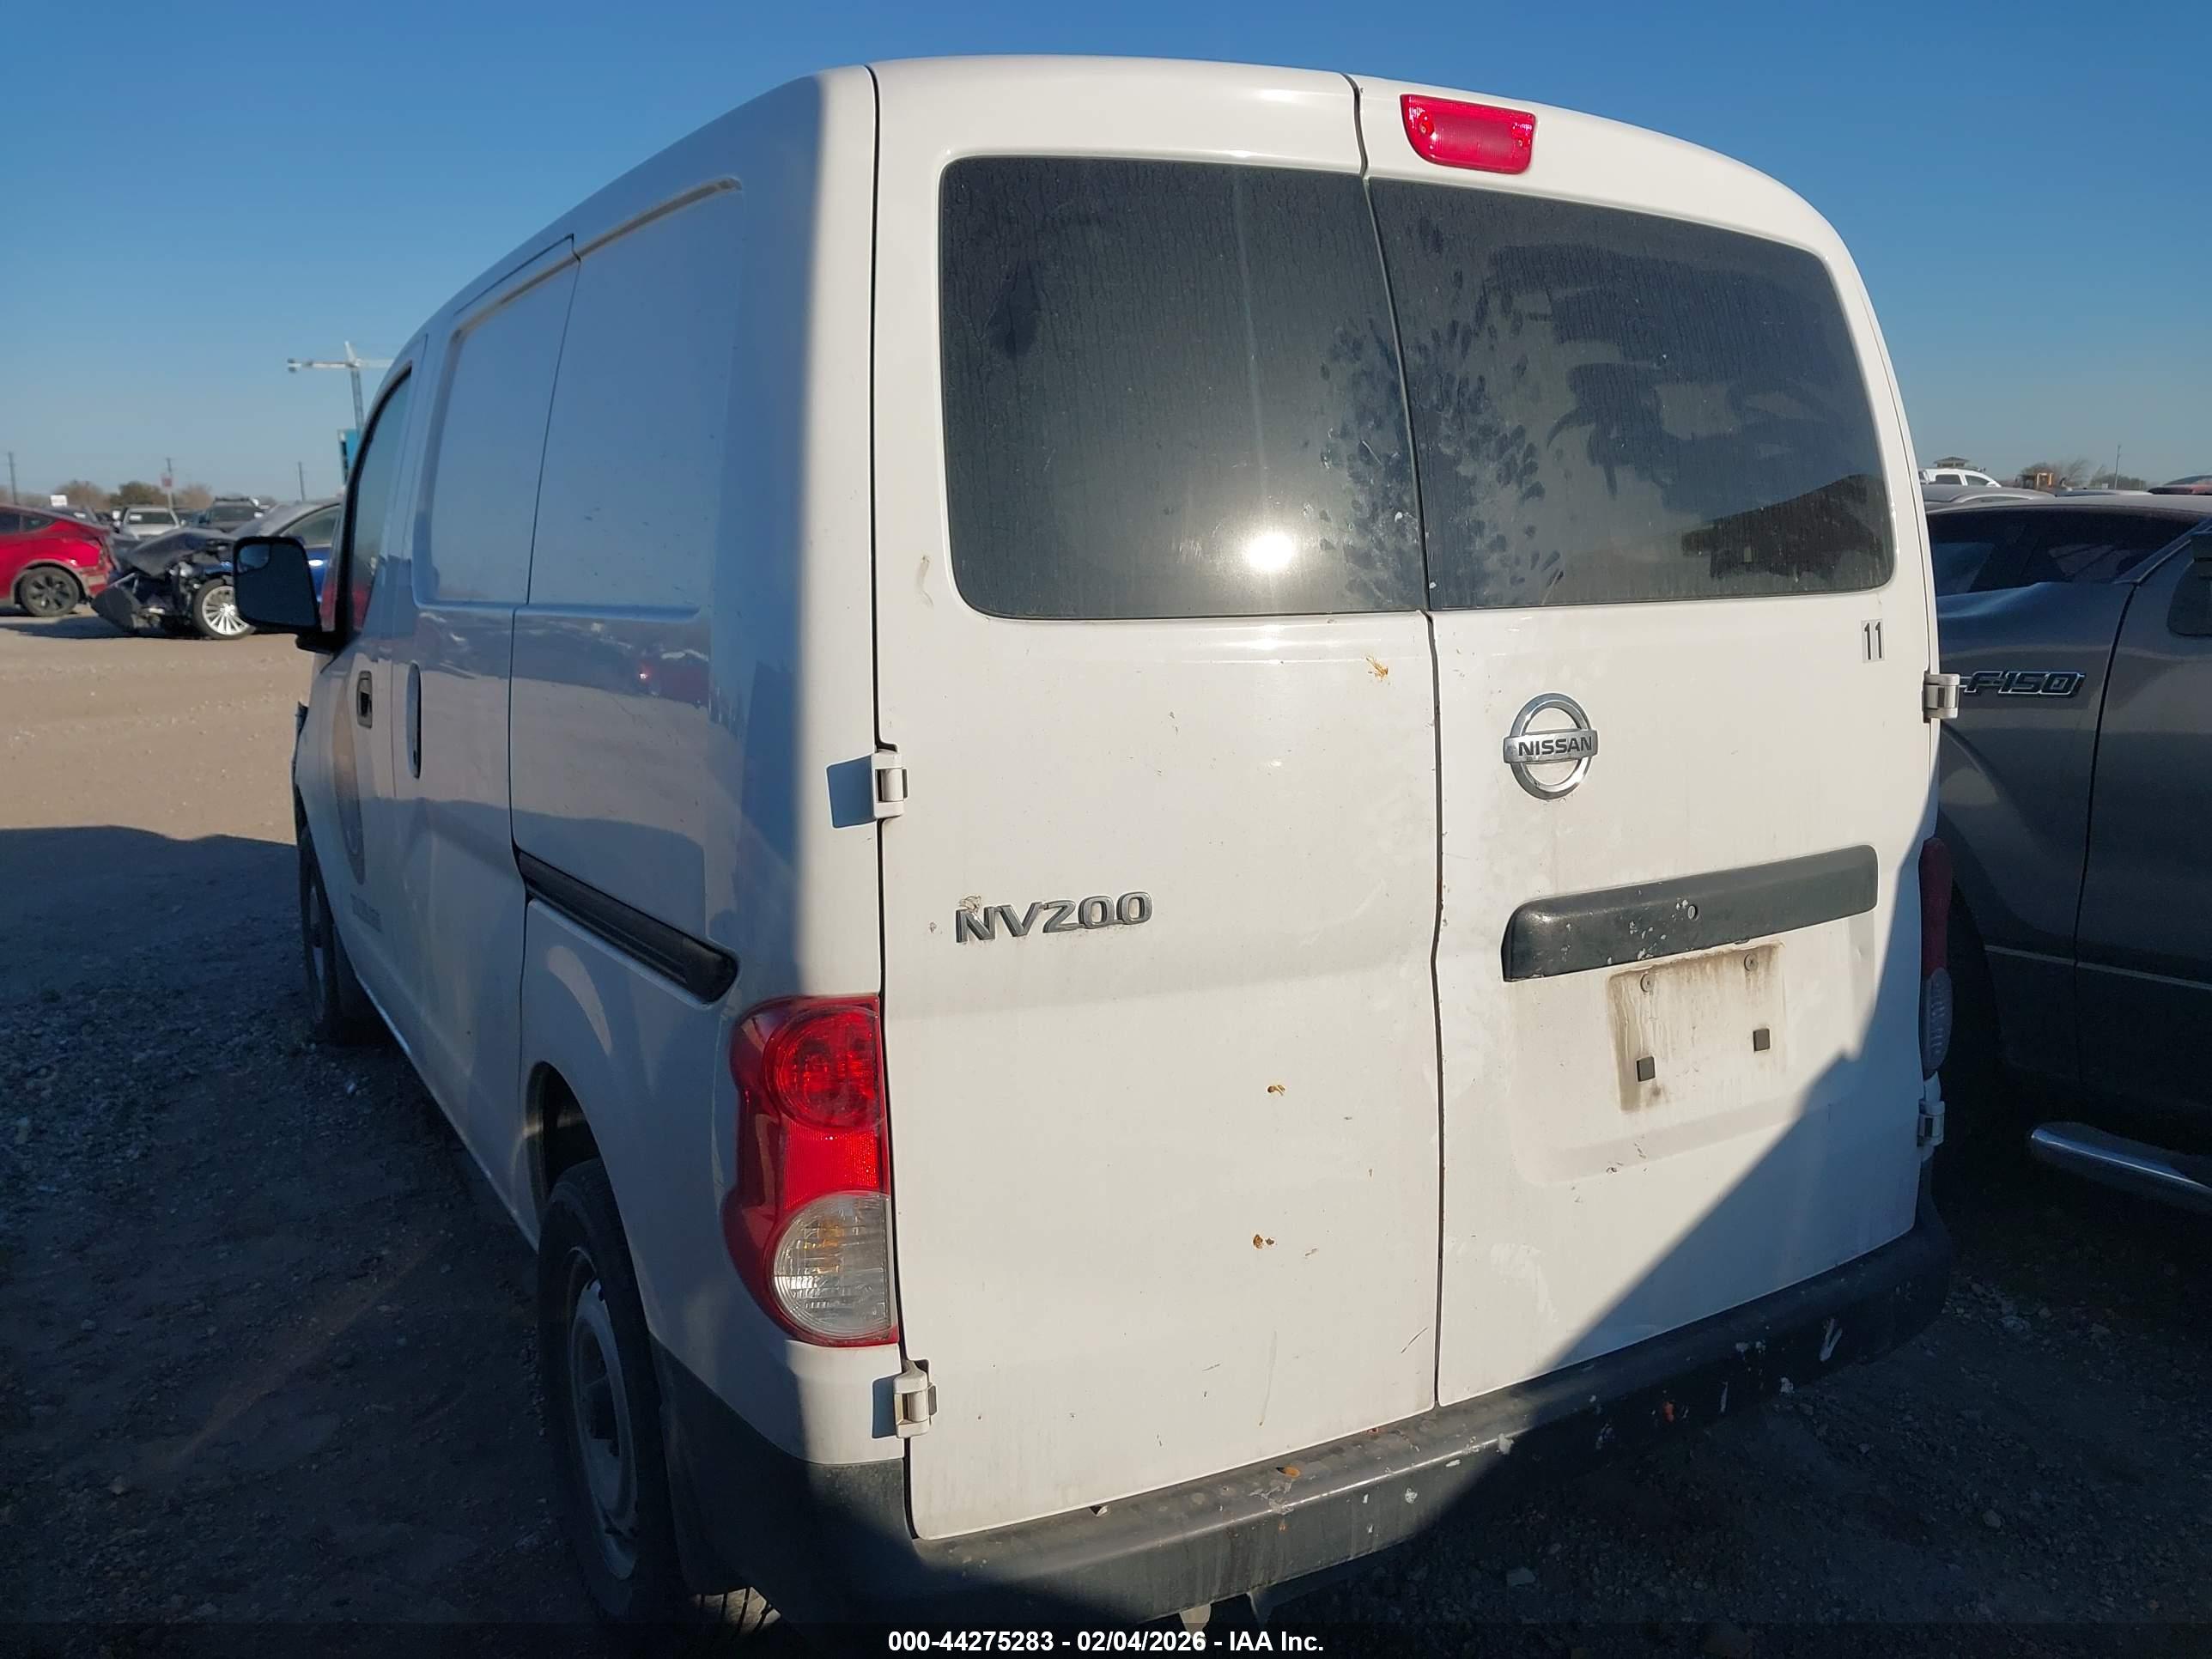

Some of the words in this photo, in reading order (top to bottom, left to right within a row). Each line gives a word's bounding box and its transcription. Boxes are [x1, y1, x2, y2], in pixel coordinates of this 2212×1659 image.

[1863, 621, 1882, 660] 11
[1517, 736, 1592, 757] NISSAN
[955, 891, 1153, 944] NV200
